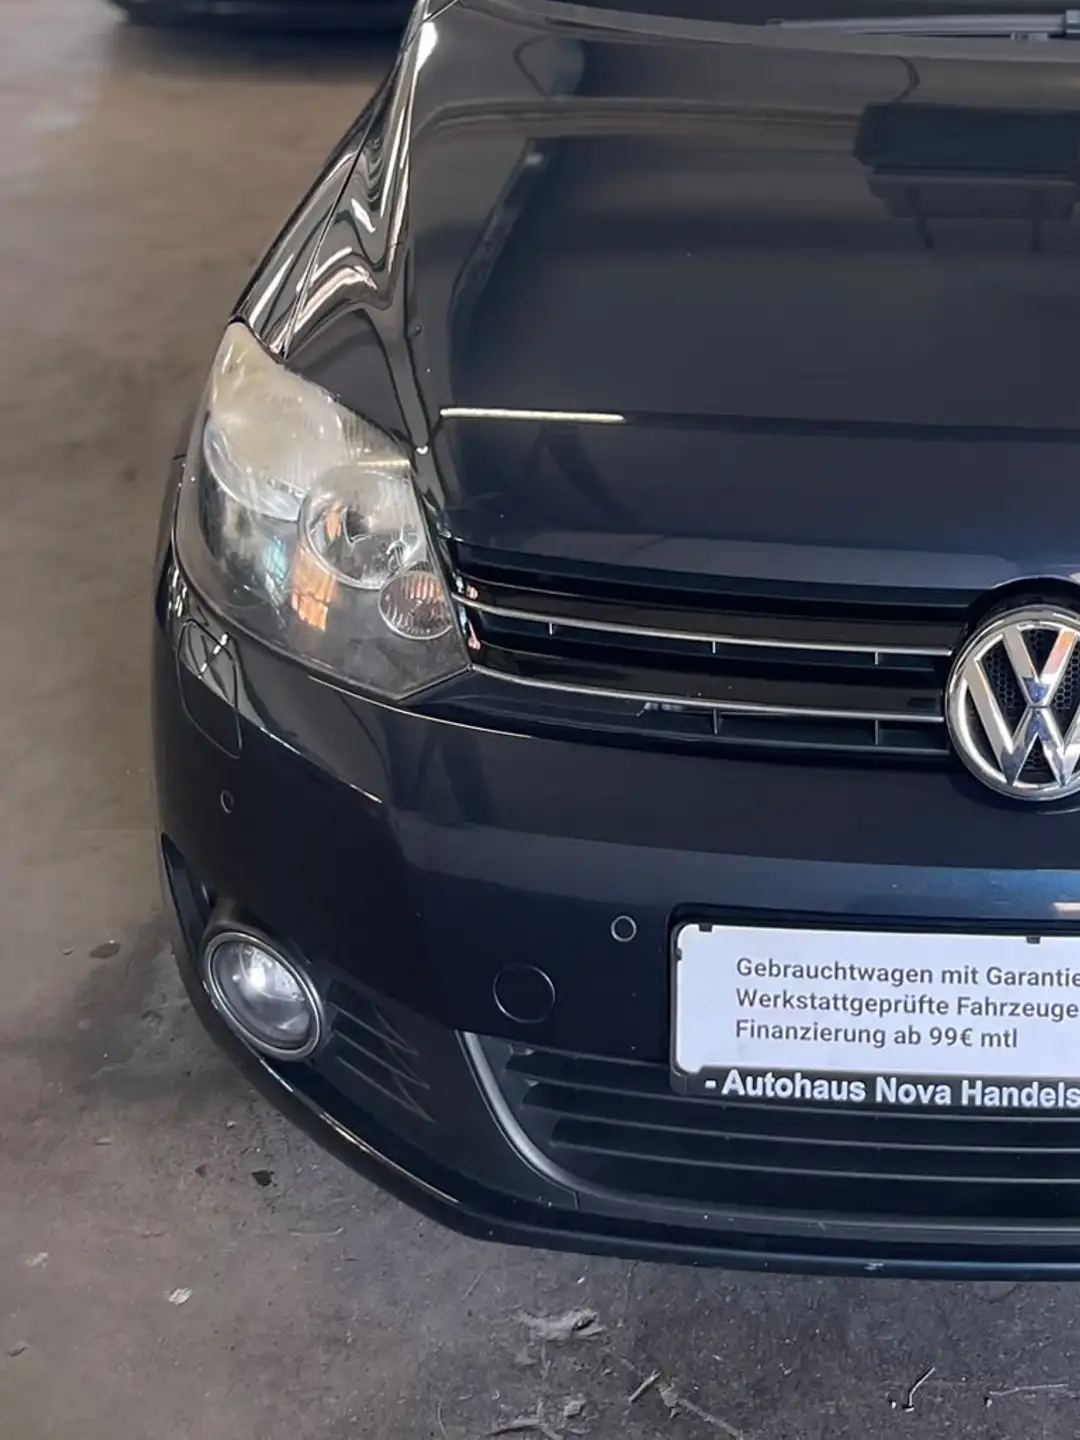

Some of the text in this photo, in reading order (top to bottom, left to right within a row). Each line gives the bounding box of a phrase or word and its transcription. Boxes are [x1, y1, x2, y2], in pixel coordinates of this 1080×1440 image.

[736, 957, 933, 987] Gebrauchtwagen
[941, 964, 979, 985] mit
[736, 988, 1079, 1023] Werkstattgeprüfte Fahrzeuge
[736, 1018, 1018, 1049] Finanzierung ab 99€ mtl
[721, 1069, 866, 1102] Autohaus
[876, 1076, 951, 1104] Nova
